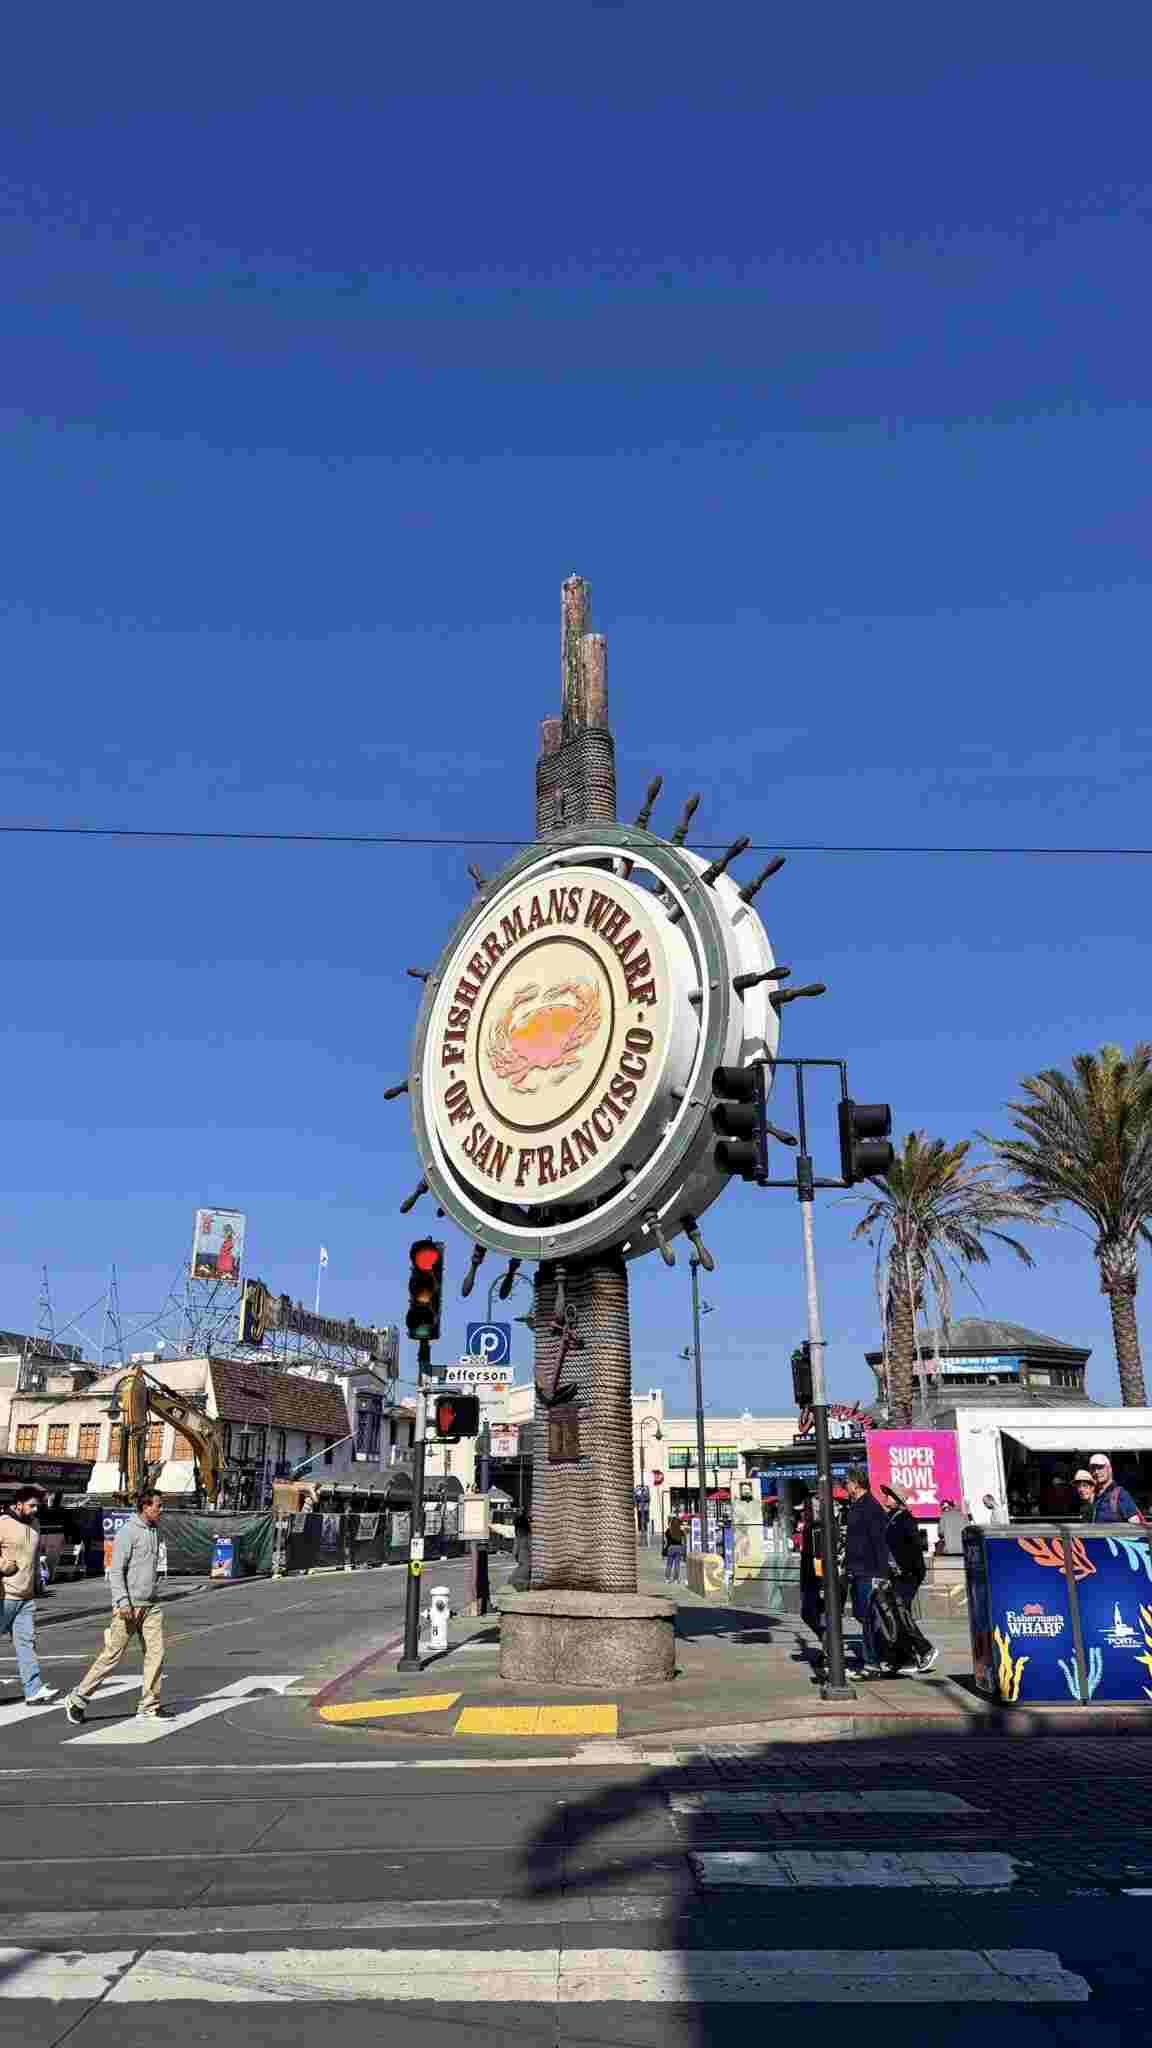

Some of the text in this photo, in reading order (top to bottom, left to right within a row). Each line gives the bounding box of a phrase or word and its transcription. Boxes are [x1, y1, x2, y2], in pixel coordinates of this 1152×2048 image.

[441, 886, 658, 1069] FISHERMANS WHARF
[442, 1026, 656, 1188] OF SAN FRANCISCO
[439, 1368, 507, 1382] Jefferson
[889, 1446, 934, 1466] SUPER
[891, 1467, 937, 1488] BOWL
[1008, 1622, 1064, 1635] WHARF
